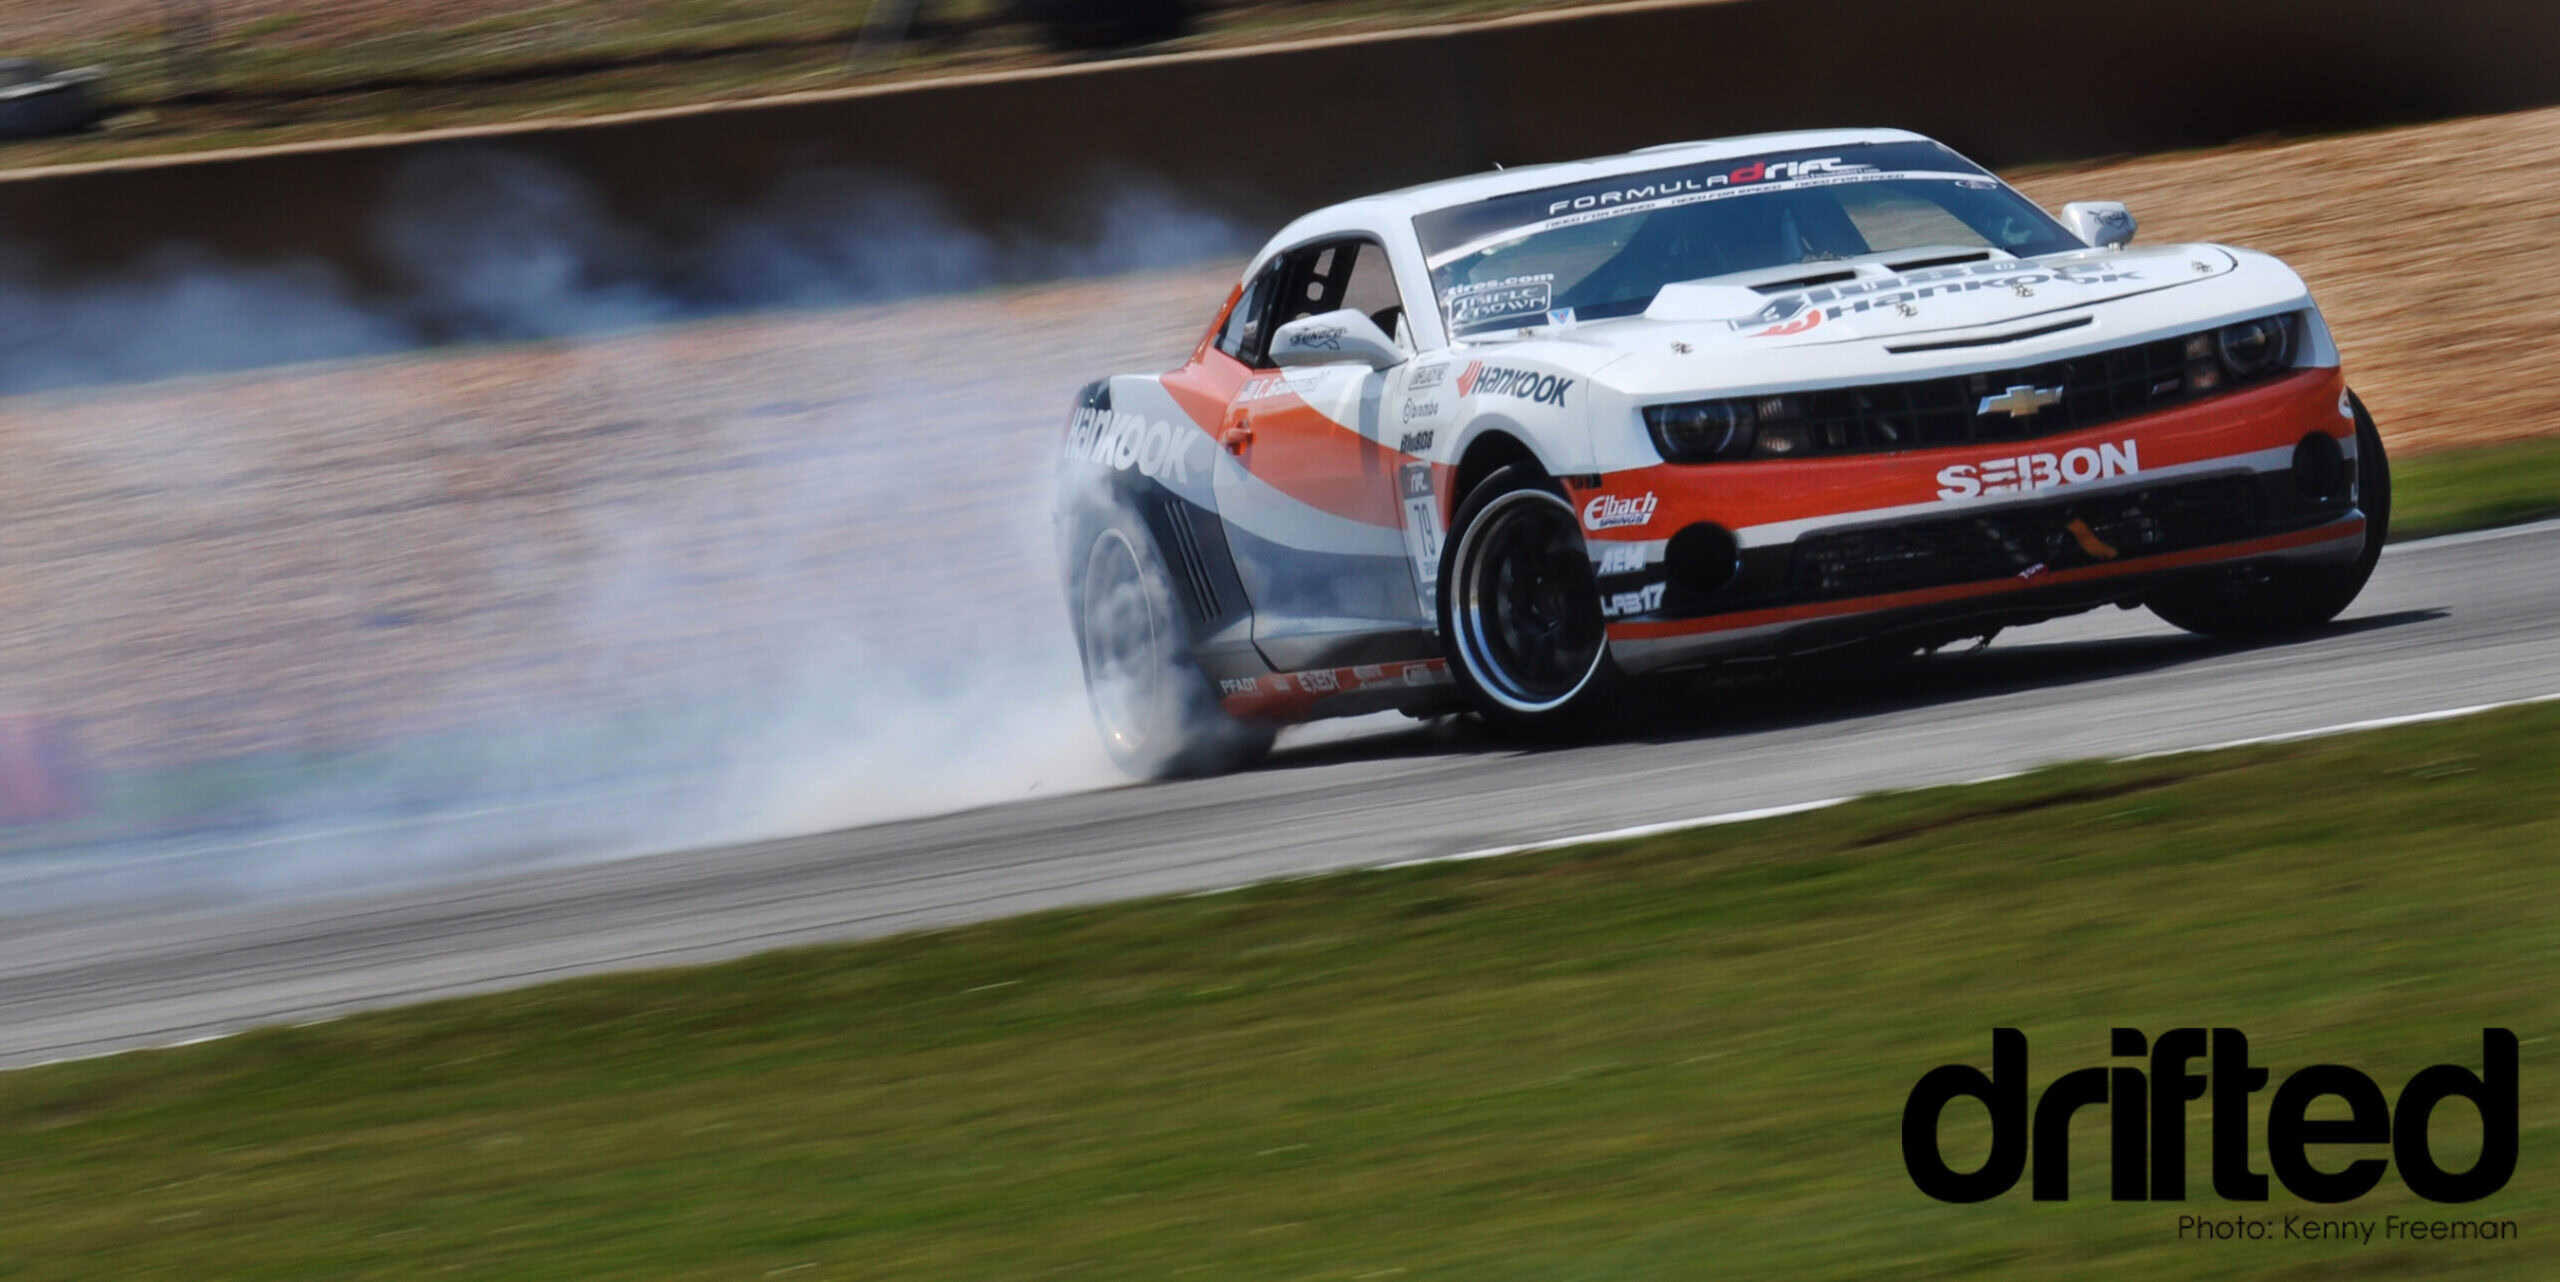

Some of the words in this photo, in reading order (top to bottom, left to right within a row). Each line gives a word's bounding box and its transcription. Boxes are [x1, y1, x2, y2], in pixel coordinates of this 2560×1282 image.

[1549, 173, 1730, 215] FORMULA
[1936, 439, 2139, 500] SEIBON
[1583, 491, 1658, 530] Eibach
[1597, 544, 1646, 577] AEM
[1600, 581, 1666, 617] LAB17
